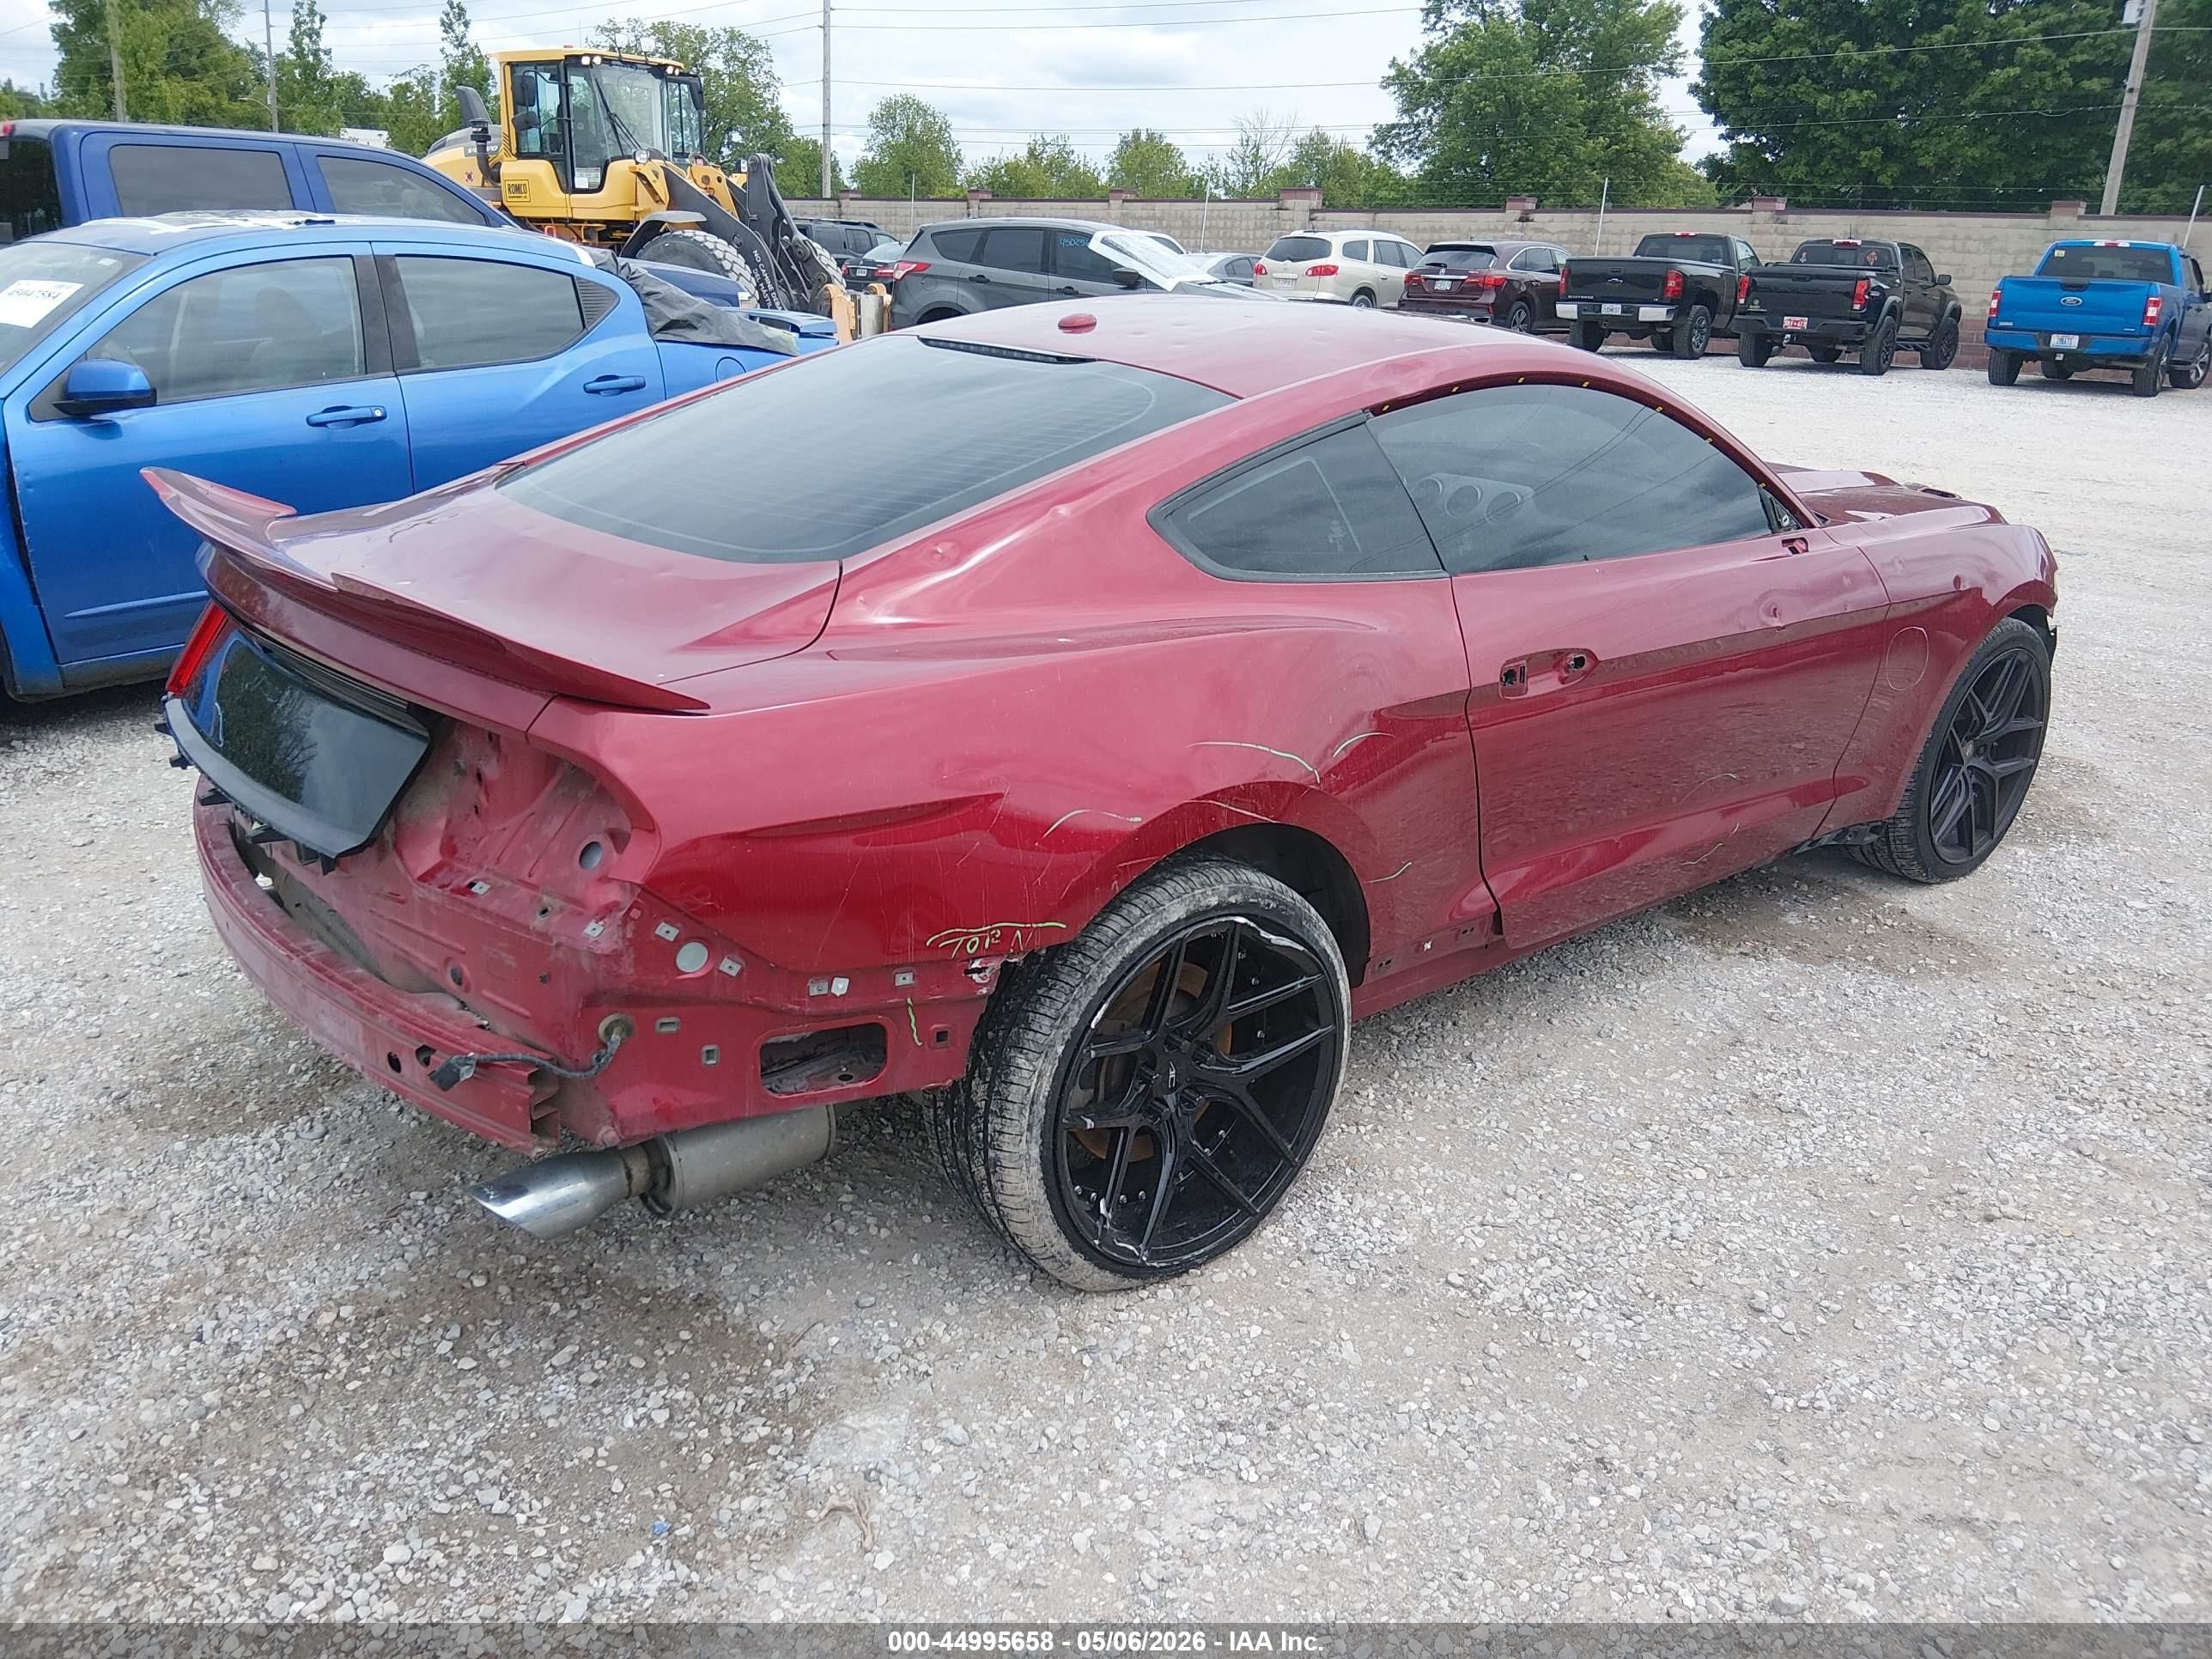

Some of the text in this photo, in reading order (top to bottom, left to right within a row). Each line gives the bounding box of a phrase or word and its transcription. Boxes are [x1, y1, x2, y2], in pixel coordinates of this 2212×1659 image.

[507, 183, 528, 195] ROMCO
[752, 249, 762, 263] NO
[758, 263, 775, 292] CAMINE
[752, 268, 762, 283] DEL
